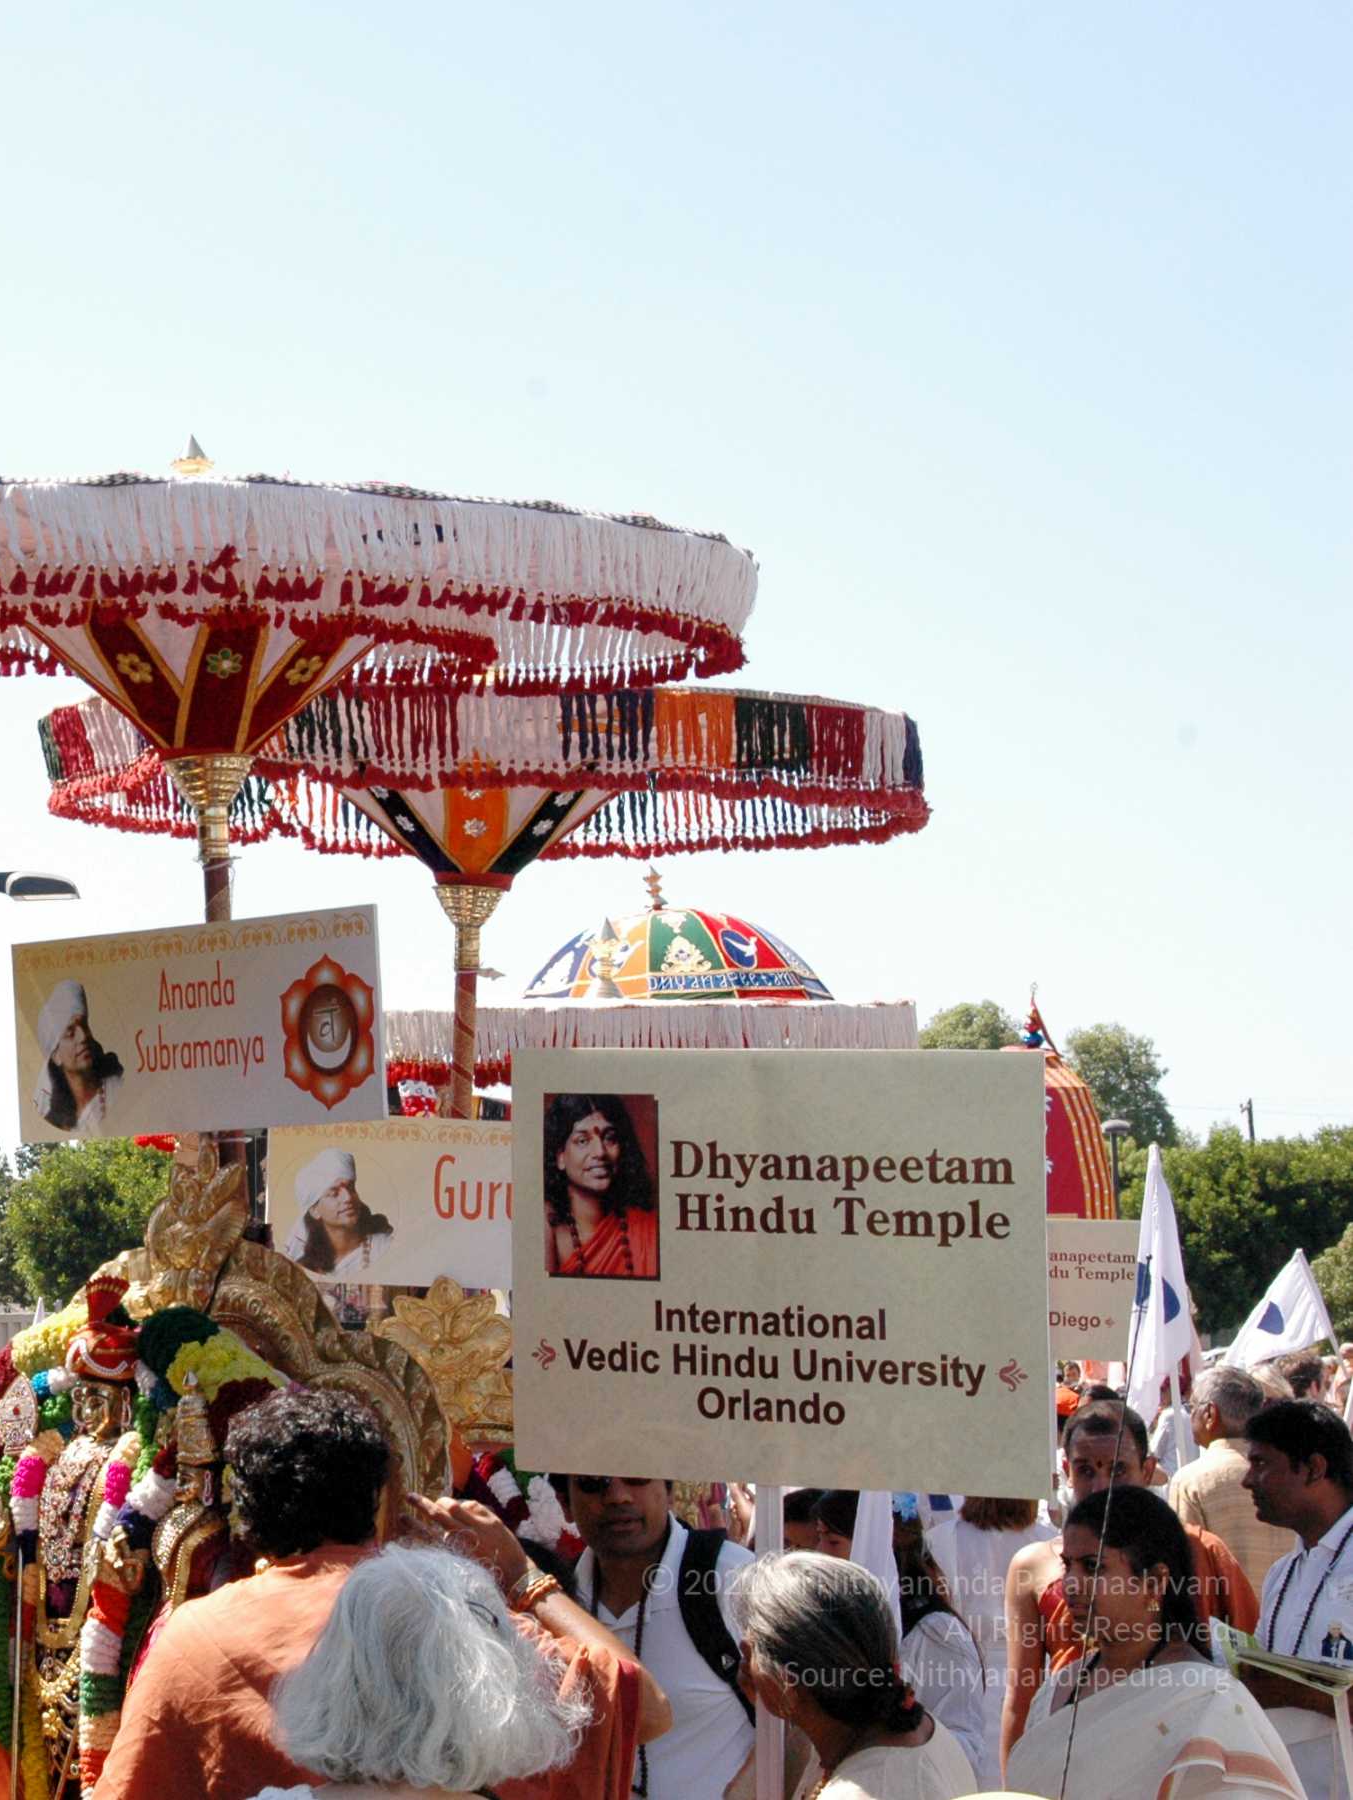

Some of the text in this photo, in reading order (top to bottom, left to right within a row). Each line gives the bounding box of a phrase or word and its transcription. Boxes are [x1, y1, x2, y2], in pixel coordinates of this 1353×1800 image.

[158, 960, 235, 1012] Ananda
[136, 1025, 265, 1076] Subramanya
[669, 1140, 1015, 1191] Dhyanapeetam
[675, 1193, 1011, 1247] Hindu Temple
[1074, 1266, 1135, 1284] Temple
[654, 1299, 886, 1341] International
[1049, 1311, 1102, 1332] Diego
[564, 1338, 986, 1397] Vedic Hindu University
[697, 1387, 846, 1426] Orlando
